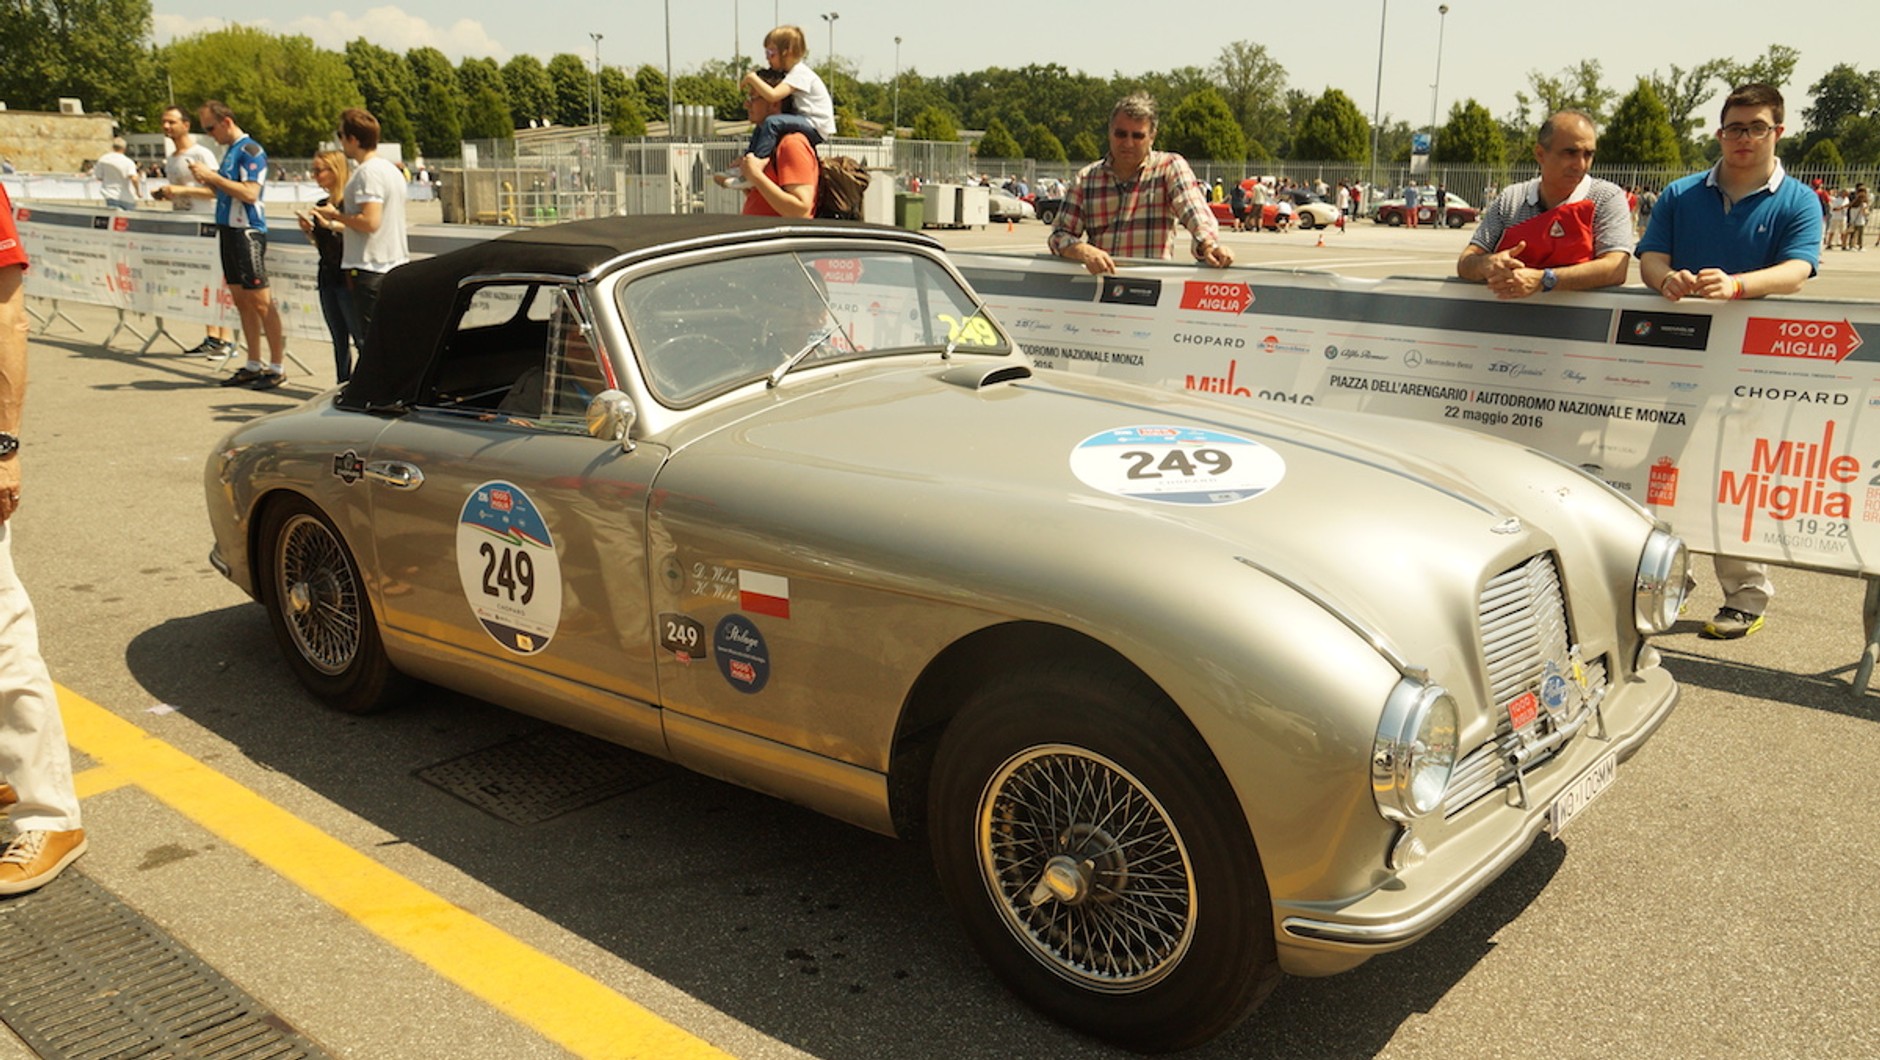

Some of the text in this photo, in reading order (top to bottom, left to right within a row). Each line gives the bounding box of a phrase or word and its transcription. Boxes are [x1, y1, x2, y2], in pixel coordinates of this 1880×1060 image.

[1203, 284, 1240, 297] 1000
[829, 303, 859, 314] PARD
[1197, 298, 1240, 311] MIGLIA
[937, 313, 998, 347] 249
[1778, 322, 1838, 338] 1000
[1173, 333, 1246, 349] CHOPARD
[1770, 339, 1838, 358] MIGLIA
[1061, 347, 1110, 363] NAZIONALE
[1111, 352, 1145, 367] MONZA
[1330, 374, 1687, 426] PIAZZA DELL'ARENGARIO AUTODROMO NAZIONALE MONZA
[1734, 385, 1849, 405] CHOPARD
[1444, 405, 1543, 428] 22 maggio 2016
[1751, 419, 1860, 484] Mille
[1119, 448, 1233, 480] 249
[1717, 470, 1851, 543] Miglia
[1796, 519, 1849, 540] 19-22
[479, 541, 535, 606] 249
[667, 621, 698, 647] 249
